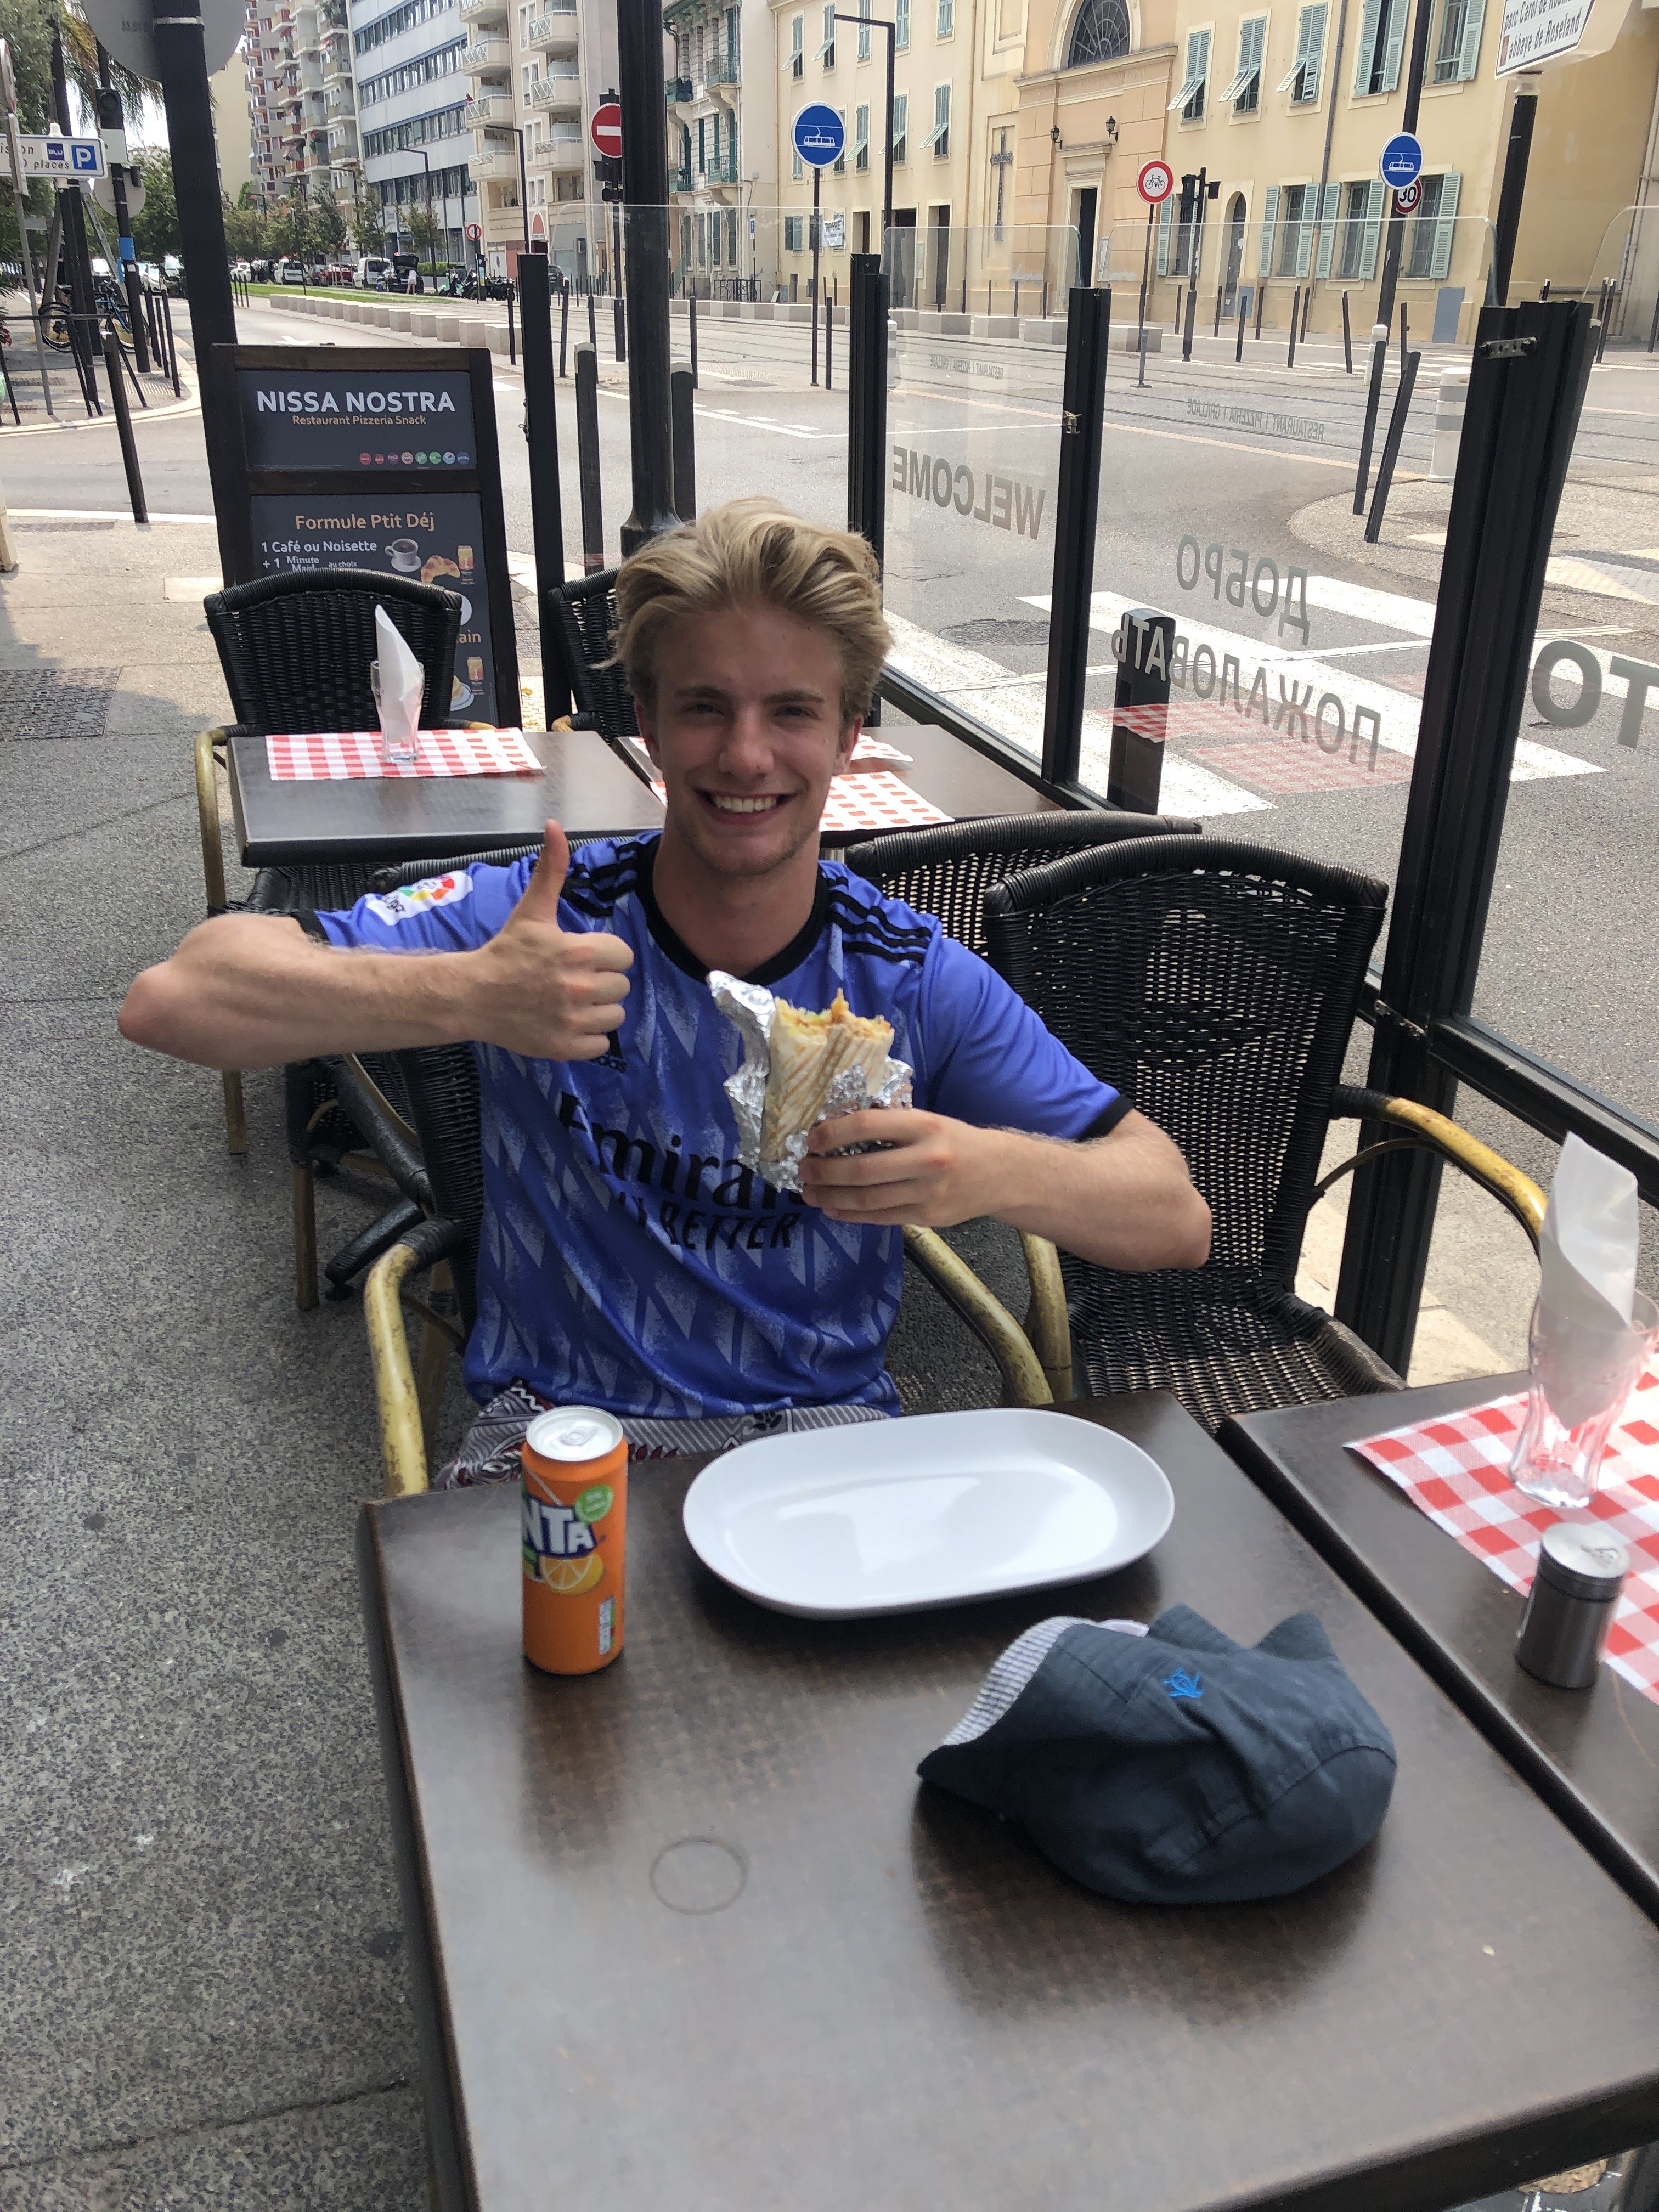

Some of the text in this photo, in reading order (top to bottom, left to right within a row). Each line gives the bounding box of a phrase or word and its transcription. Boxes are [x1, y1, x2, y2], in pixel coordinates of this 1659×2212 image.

[1504, 9, 1519, 33] parc
[1509, 6, 1582, 59] abbaye de Roseland
[34, 159, 70, 171] places
[1399, 186, 1416, 203] 30
[257, 391, 456, 413] NISSA NOSTRA
[292, 415, 426, 425] Restaurant Pizzeria Snack
[295, 512, 435, 532] Formule Ptit Déj
[261, 540, 377, 554] 1 Café ou Noisette
[274, 558, 280, 569] 1
[286, 555, 320, 565] Minute
[457, 629, 482, 644] ain
[522, 1496, 595, 1555] NTA
